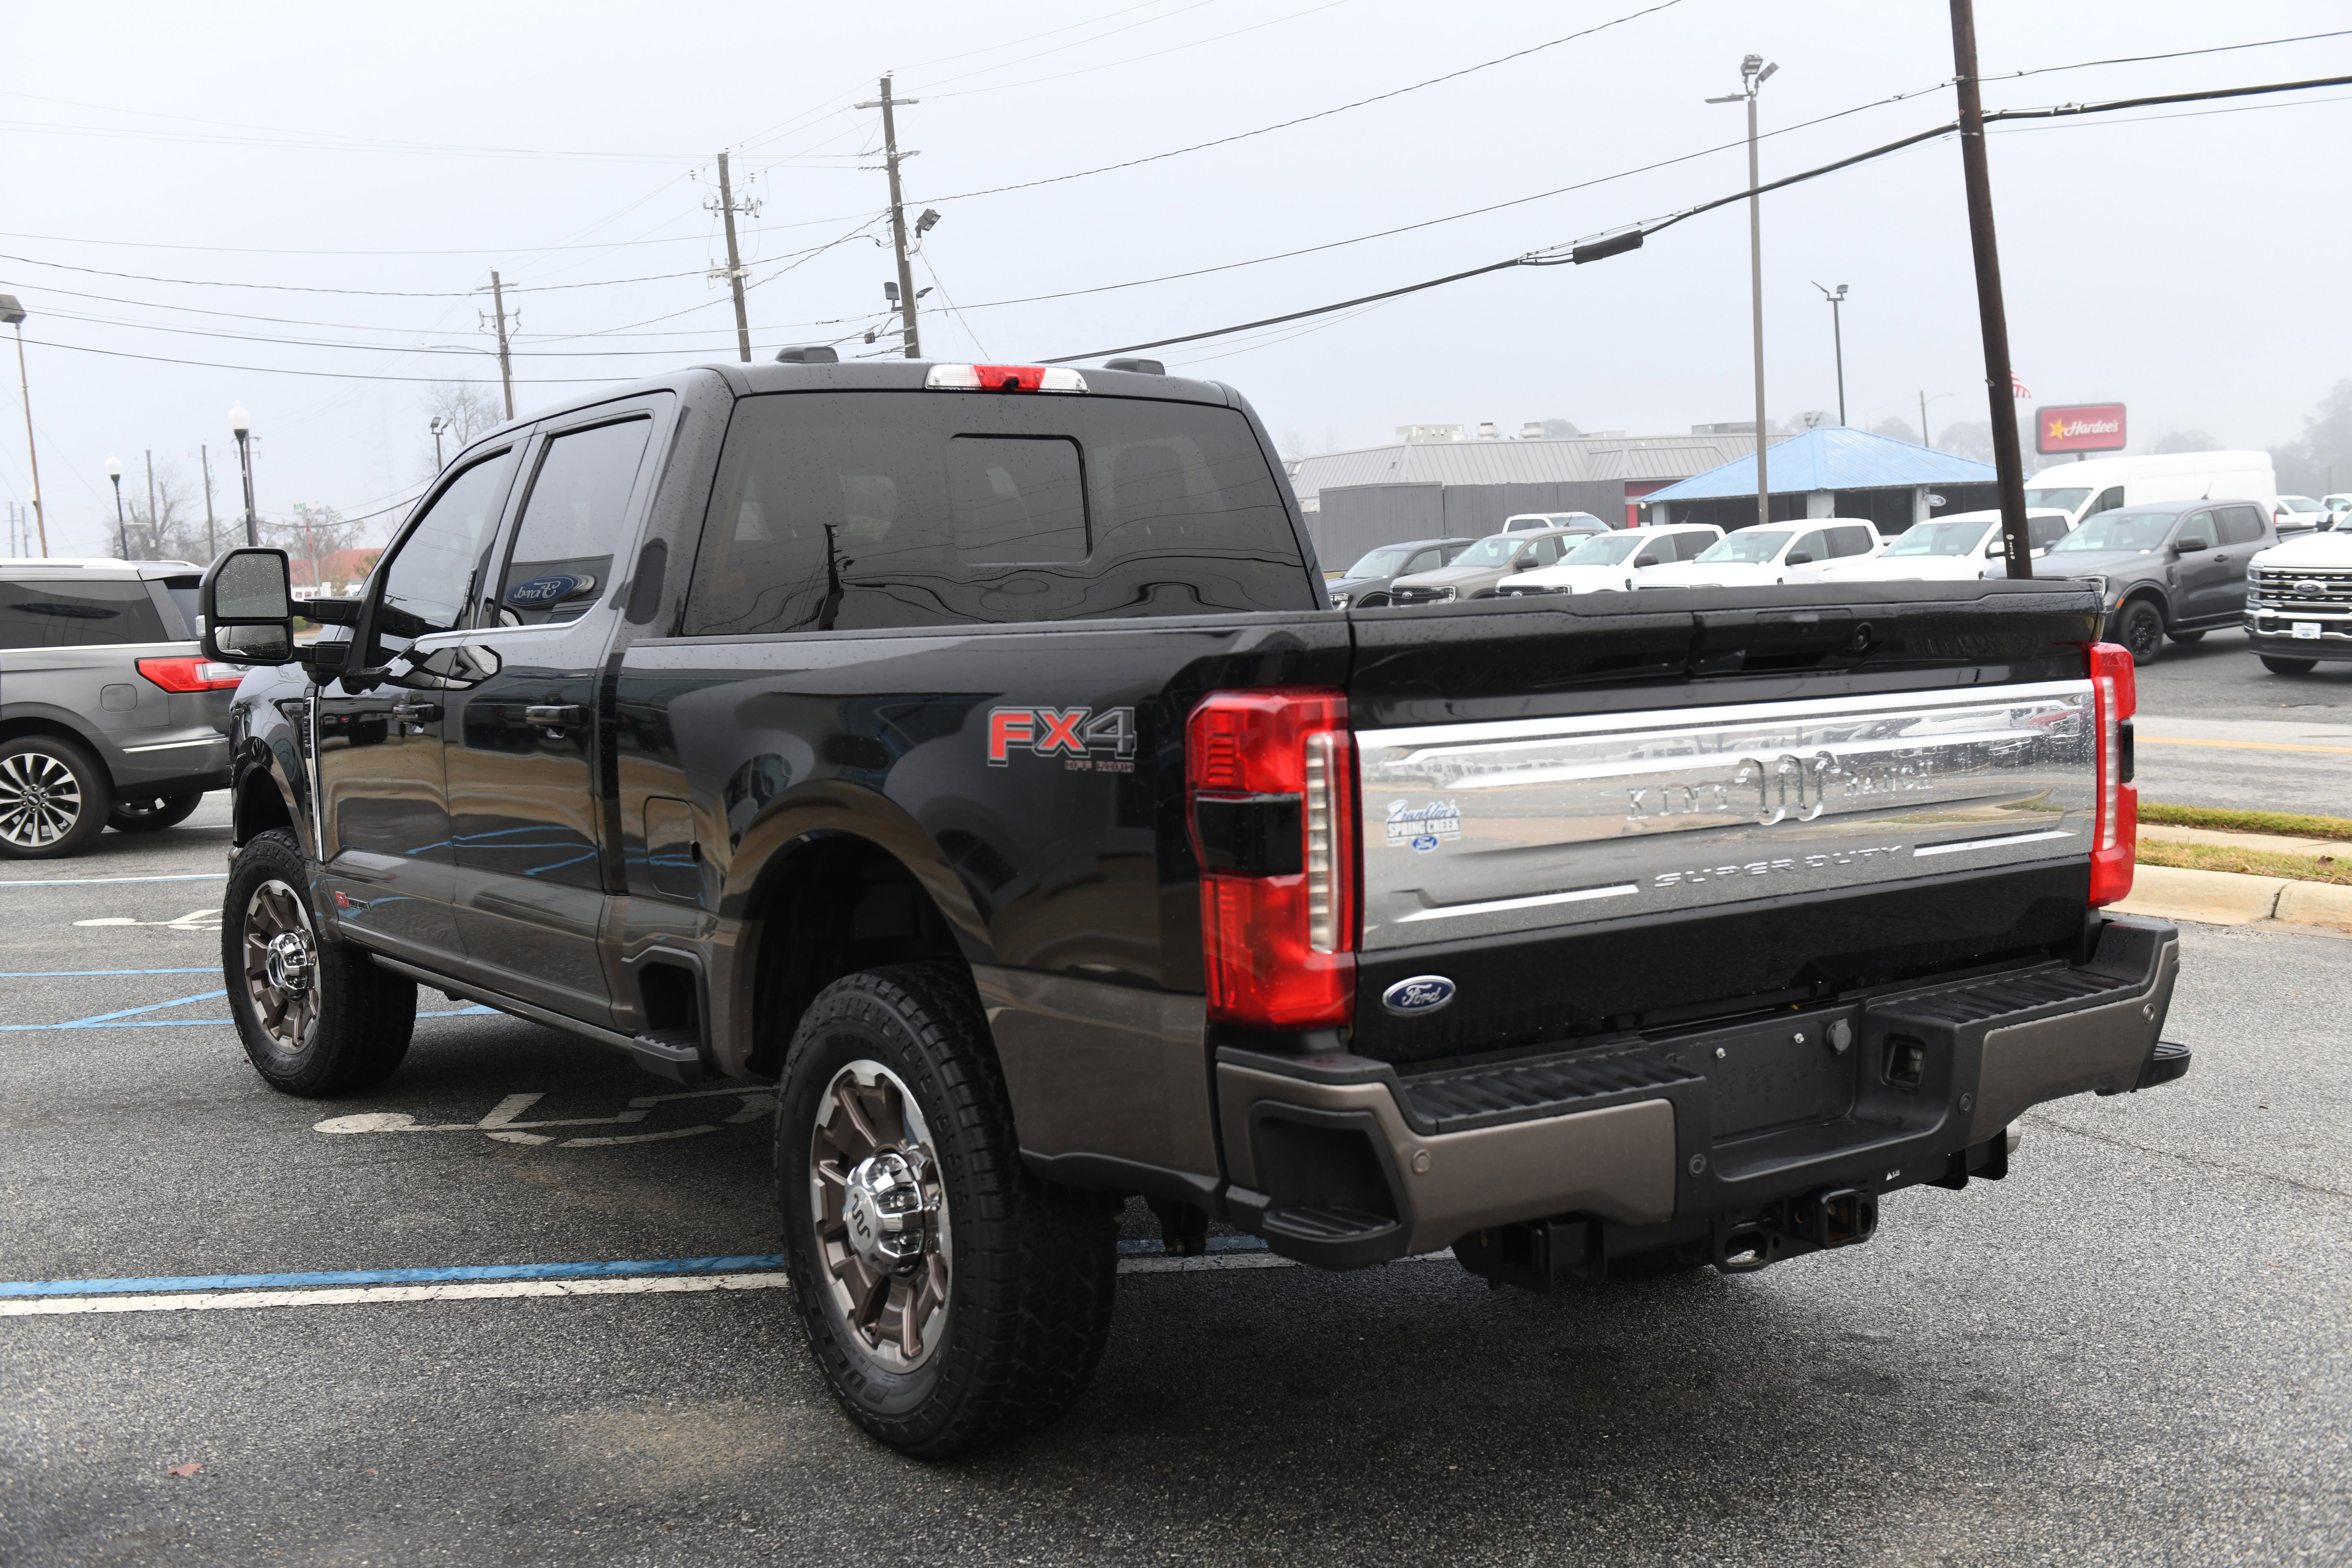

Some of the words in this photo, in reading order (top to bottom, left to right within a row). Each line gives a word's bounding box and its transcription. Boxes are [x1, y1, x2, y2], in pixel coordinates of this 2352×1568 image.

[2064, 419, 2119, 437] Hardee's
[987, 706, 1137, 767] FX4
[1065, 760, 1092, 771] OFF
[1096, 761, 1135, 773] ROAD
[1626, 784, 1729, 820] KING
[1844, 758, 1934, 796] RANCH
[1388, 820, 1425, 837] SPRING
[1426, 817, 1459, 834] CREEK
[1415, 837, 1435, 850] Ford
[1655, 858, 1795, 887] SUPER
[1806, 845, 1902, 869] DUTY
[1401, 983, 1442, 1006] Ford
